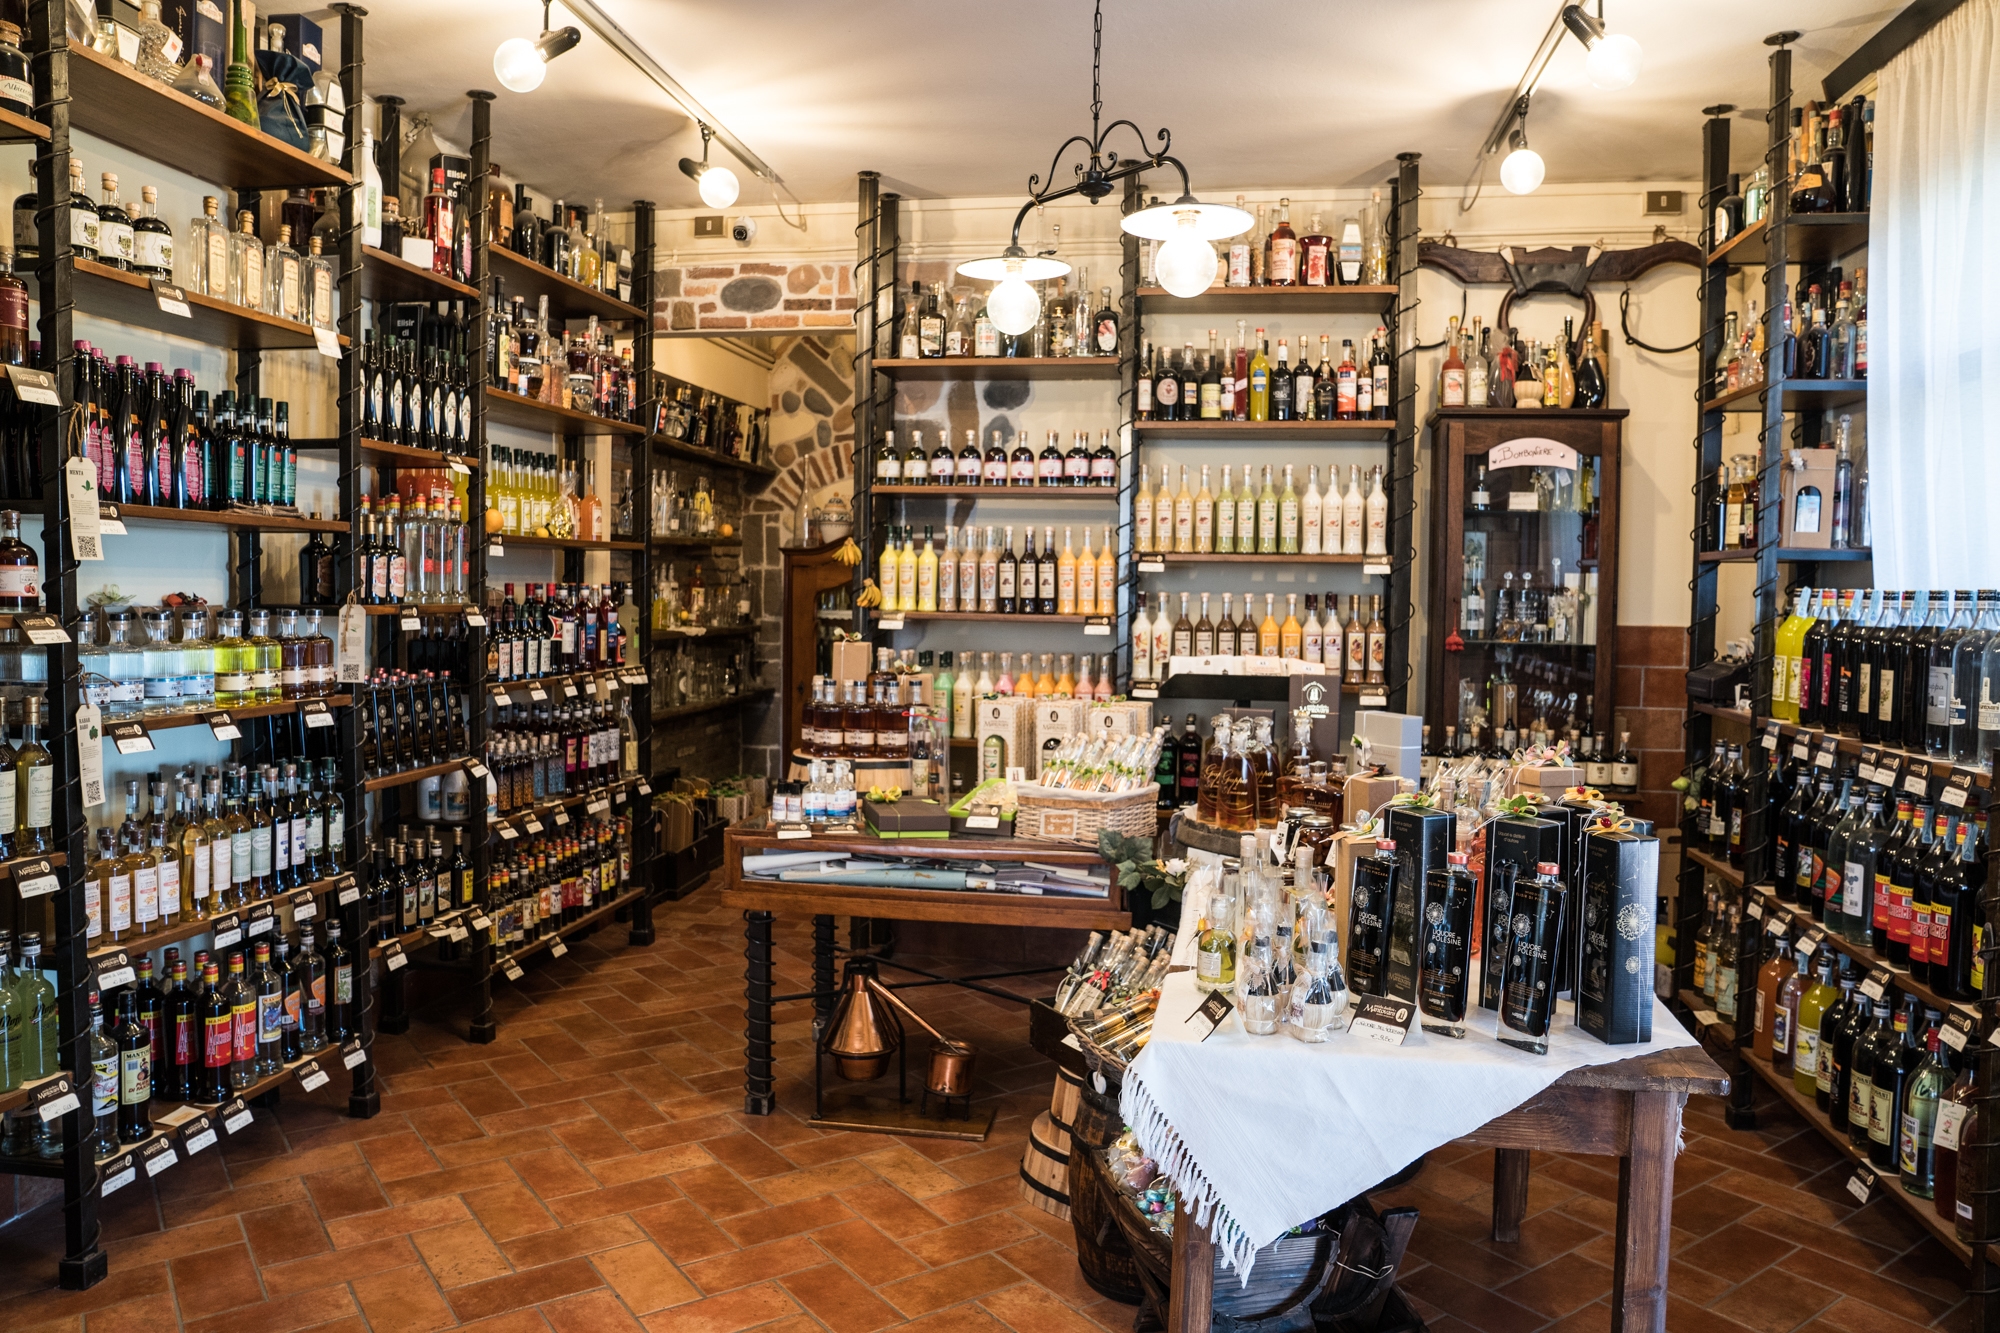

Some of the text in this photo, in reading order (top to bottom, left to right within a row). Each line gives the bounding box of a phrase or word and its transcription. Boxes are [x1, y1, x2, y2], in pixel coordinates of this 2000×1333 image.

[446, 169, 467, 180] Elisir
[1221, 768, 1249, 787] Grappa
[1359, 912, 1377, 920] LIQUORE
[1358, 917, 1382, 929] POLESINE
[1432, 929, 1456, 940] LIQUORE
[1432, 935, 1461, 946] POLESINE
[1518, 941, 1541, 951] LIQUORE
[1518, 946, 1547, 960] POLESINE
[1363, 1004, 1396, 1017] Mantovani
